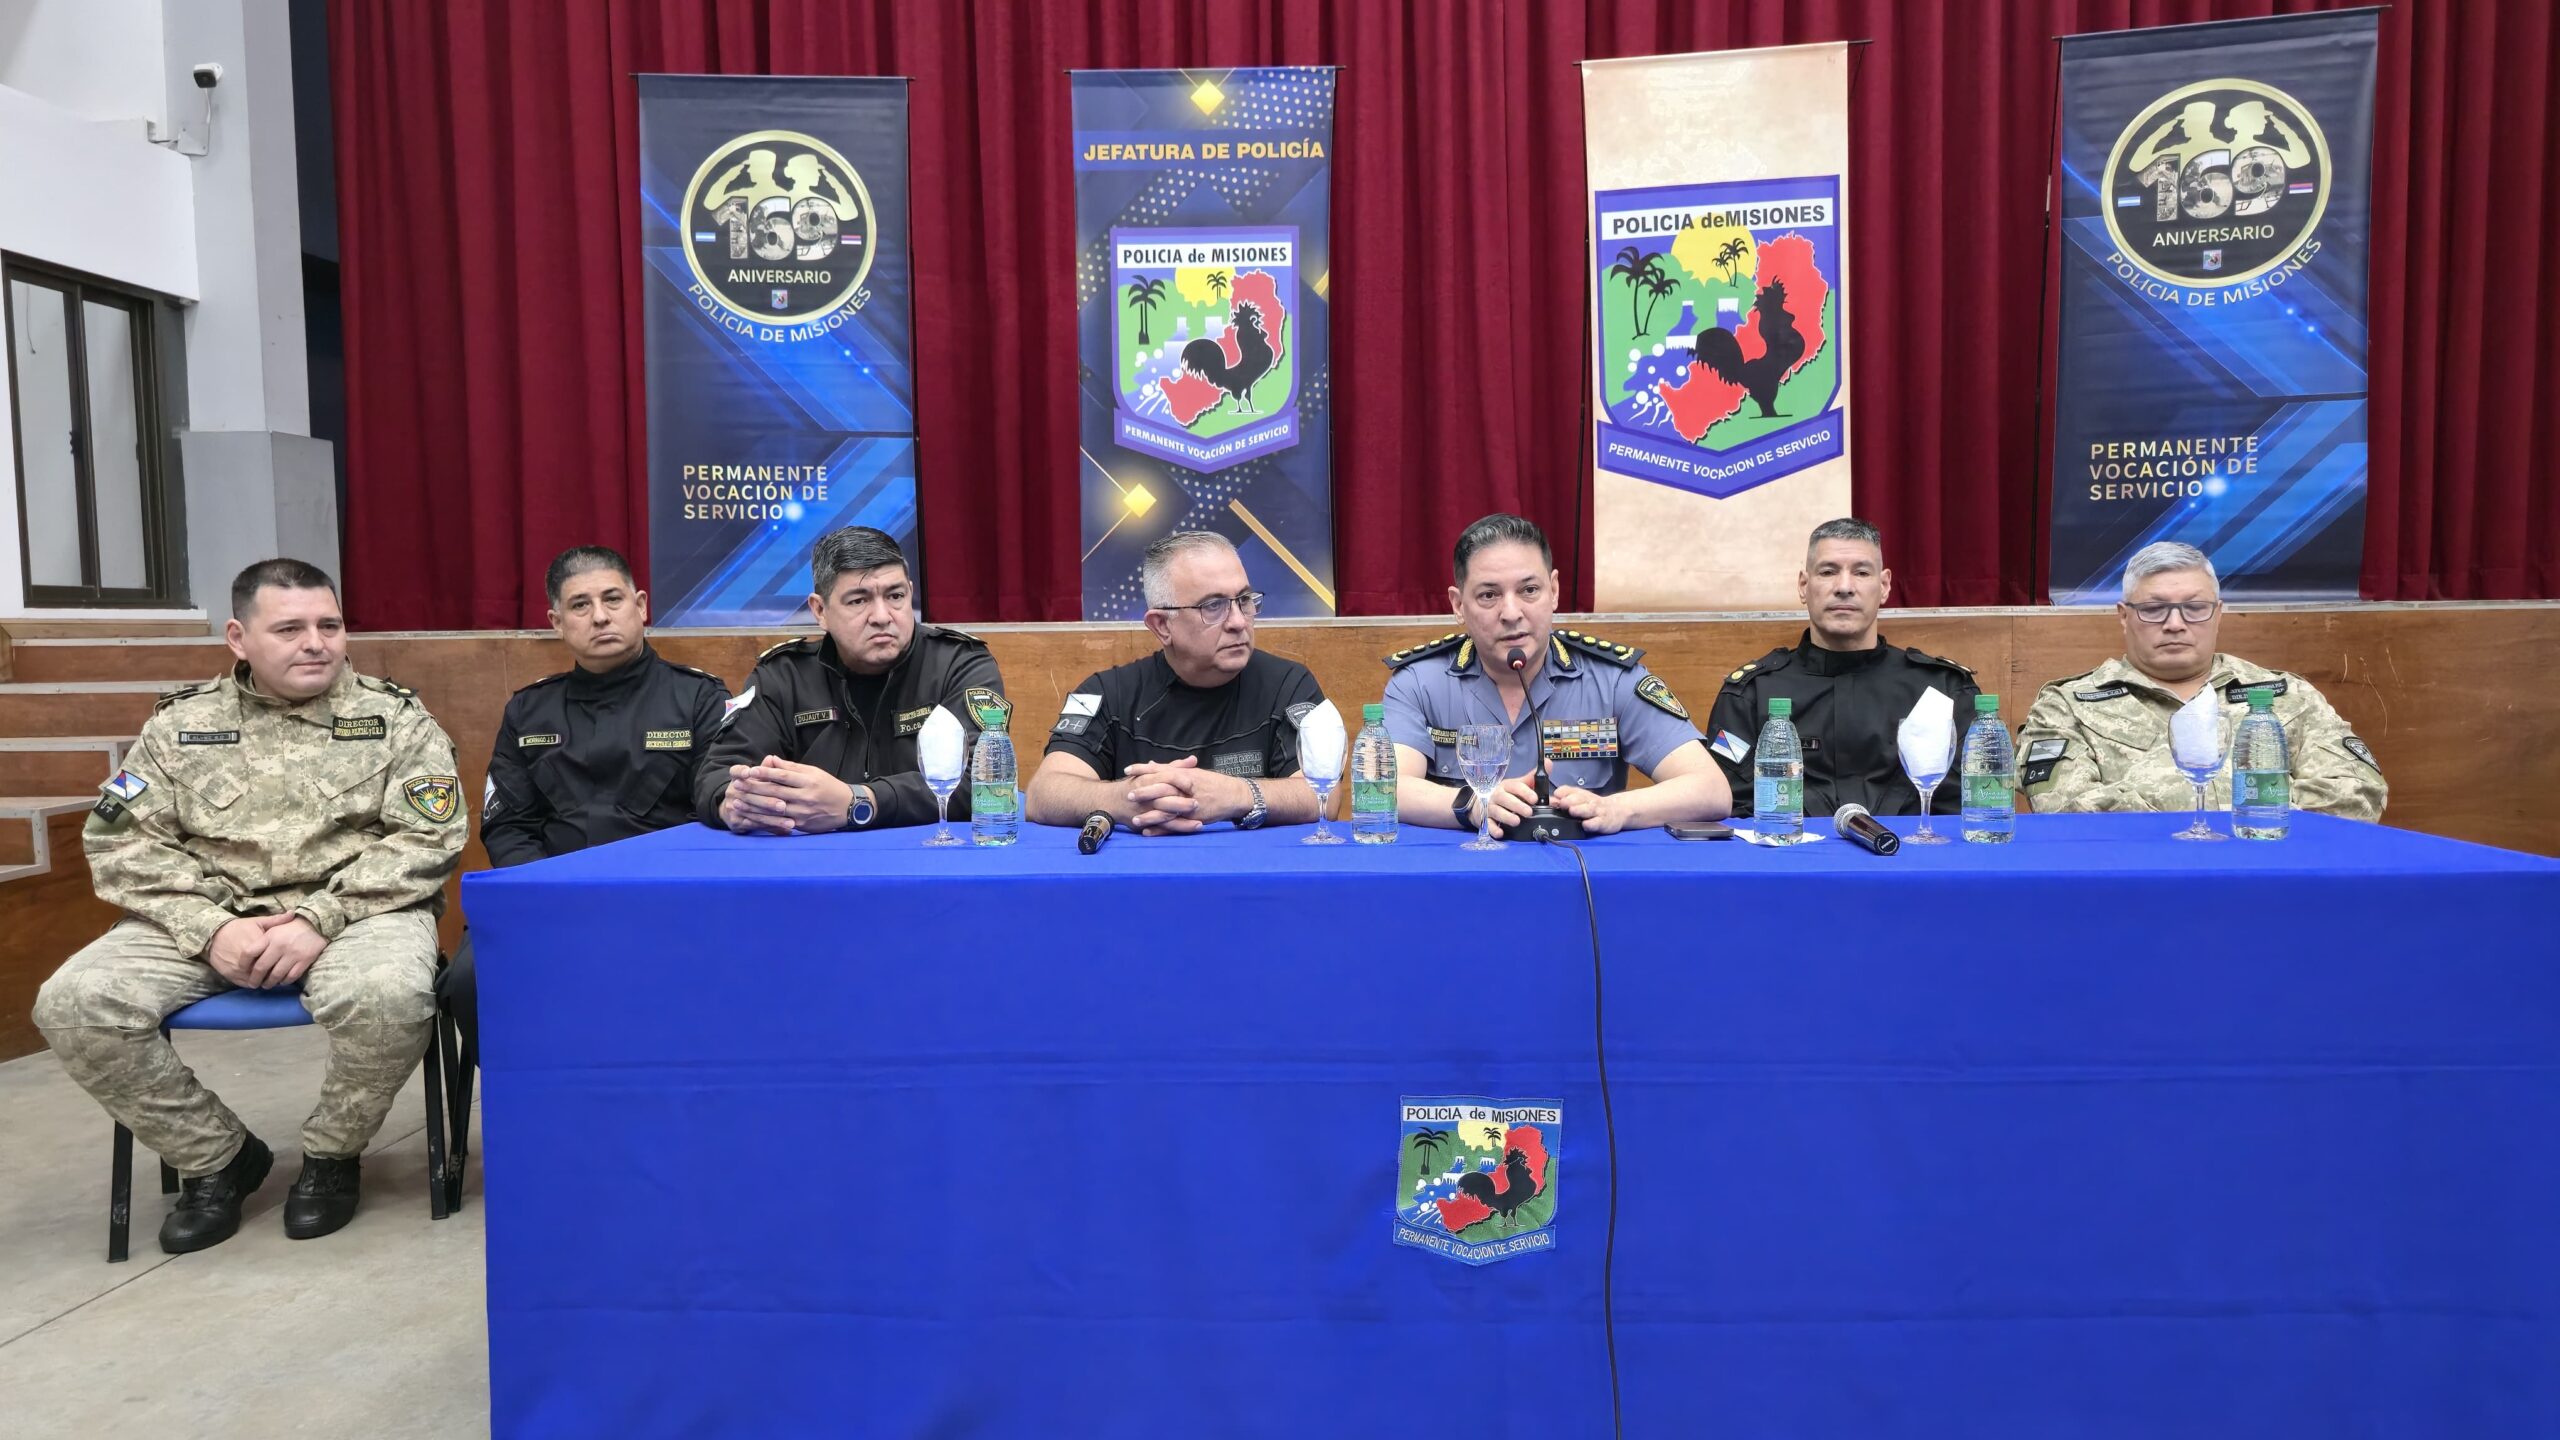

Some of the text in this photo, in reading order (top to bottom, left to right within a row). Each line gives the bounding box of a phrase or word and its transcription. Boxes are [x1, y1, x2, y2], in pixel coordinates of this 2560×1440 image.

[1084, 138, 1325, 161] JEFATURA DE POLICÍA
[2136, 146, 2287, 222] 169
[712, 197, 839, 260] 169
[1613, 213, 1694, 235] POLICIA
[2152, 224, 2275, 247] ANIVERSARIO
[1123, 246, 1287, 264] POLICIA de MISIONES
[728, 269, 832, 285] ANIVERSARIO
[2106, 238, 2322, 306] POLICIA DE MISIONES
[688, 281, 872, 343] POLICIA DE MISIONES
[1125, 424, 1289, 460] PERMANENTE VOCACIÓN DE SERVICIO
[2091, 436, 2259, 459] PERMANENTE
[1609, 430, 1831, 480] PERMANENTE VOCACION DE SERVICIO
[683, 465, 828, 481] PERMANENTE
[2089, 456, 2258, 481] VOCACIÓN DE
[683, 480, 828, 501] VOCACIÓN DE
[2089, 479, 2203, 501] SERVICIO
[684, 503, 784, 520] SERVICIO
[338, 719, 379, 728] DIRECTOR
[646, 730, 691, 739] DIRECTOR
[1406, 1107, 1556, 1123] POLICIA de MISIONES
[1398, 1228, 1449, 1251] PERMANENTE
[1497, 1244, 1509, 1255] DE
[1508, 1233, 1550, 1251] SERVICIO
